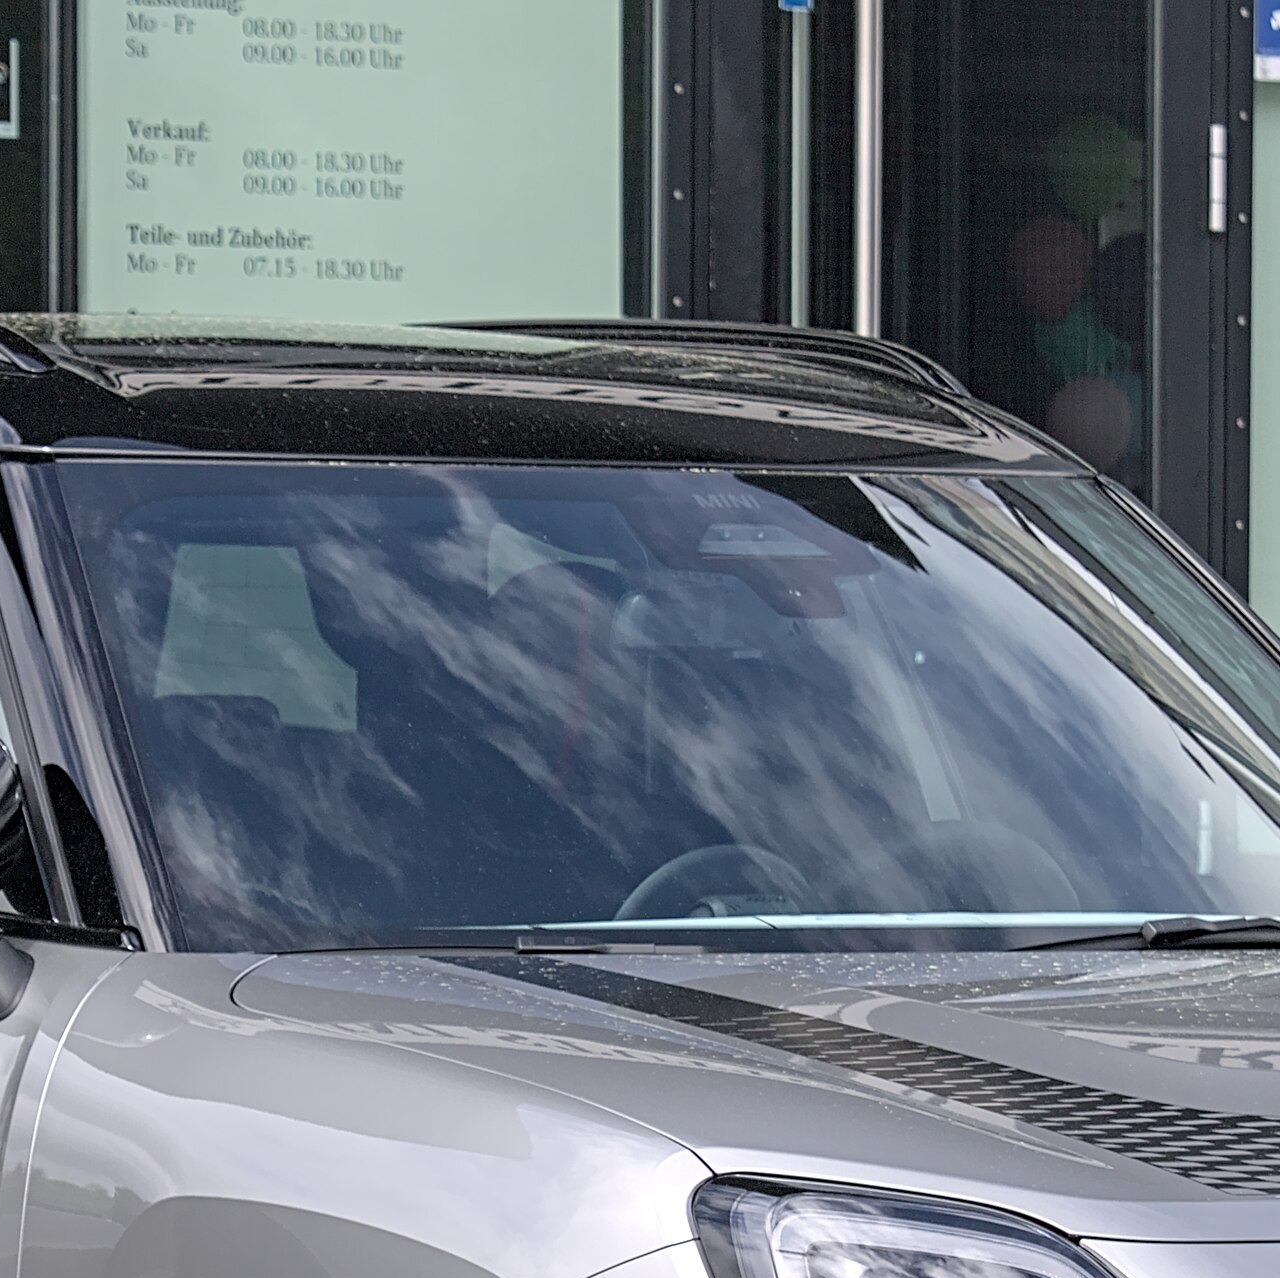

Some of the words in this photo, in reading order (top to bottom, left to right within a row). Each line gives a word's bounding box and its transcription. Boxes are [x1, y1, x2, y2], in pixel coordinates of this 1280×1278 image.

[125, 11, 157, 33] Mo
[173, 14, 196, 35] Fr
[242, 17, 297, 39] 08.00
[314, 20, 365, 42] 18.30
[369, 22, 403, 45] Uhr
[125, 36, 149, 58] Sa
[242, 42, 297, 64] 09.00
[314, 45, 365, 68] 16.00
[369, 48, 403, 70] Uhr
[126, 118, 211, 142] Verkauf:
[125, 143, 158, 165] Mo
[173, 146, 196, 167] Fr
[242, 148, 297, 170] 08.00
[314, 151, 365, 173] 18.30
[369, 153, 403, 175] Uhr
[125, 168, 149, 191] Sa
[242, 173, 297, 196] 09.00
[314, 177, 365, 199] 16.00
[369, 178, 403, 200] Uhr
[126, 223, 180, 246] Teile-
[186, 227, 224, 248] und
[228, 227, 314, 250] Zubehör:
[126, 253, 158, 274] Mo
[175, 254, 197, 275] Fr
[242, 256, 297, 278] 07.15
[315, 258, 366, 280] 18.30
[370, 260, 404, 282] Uhr
[692, 494, 760, 509] MINI
